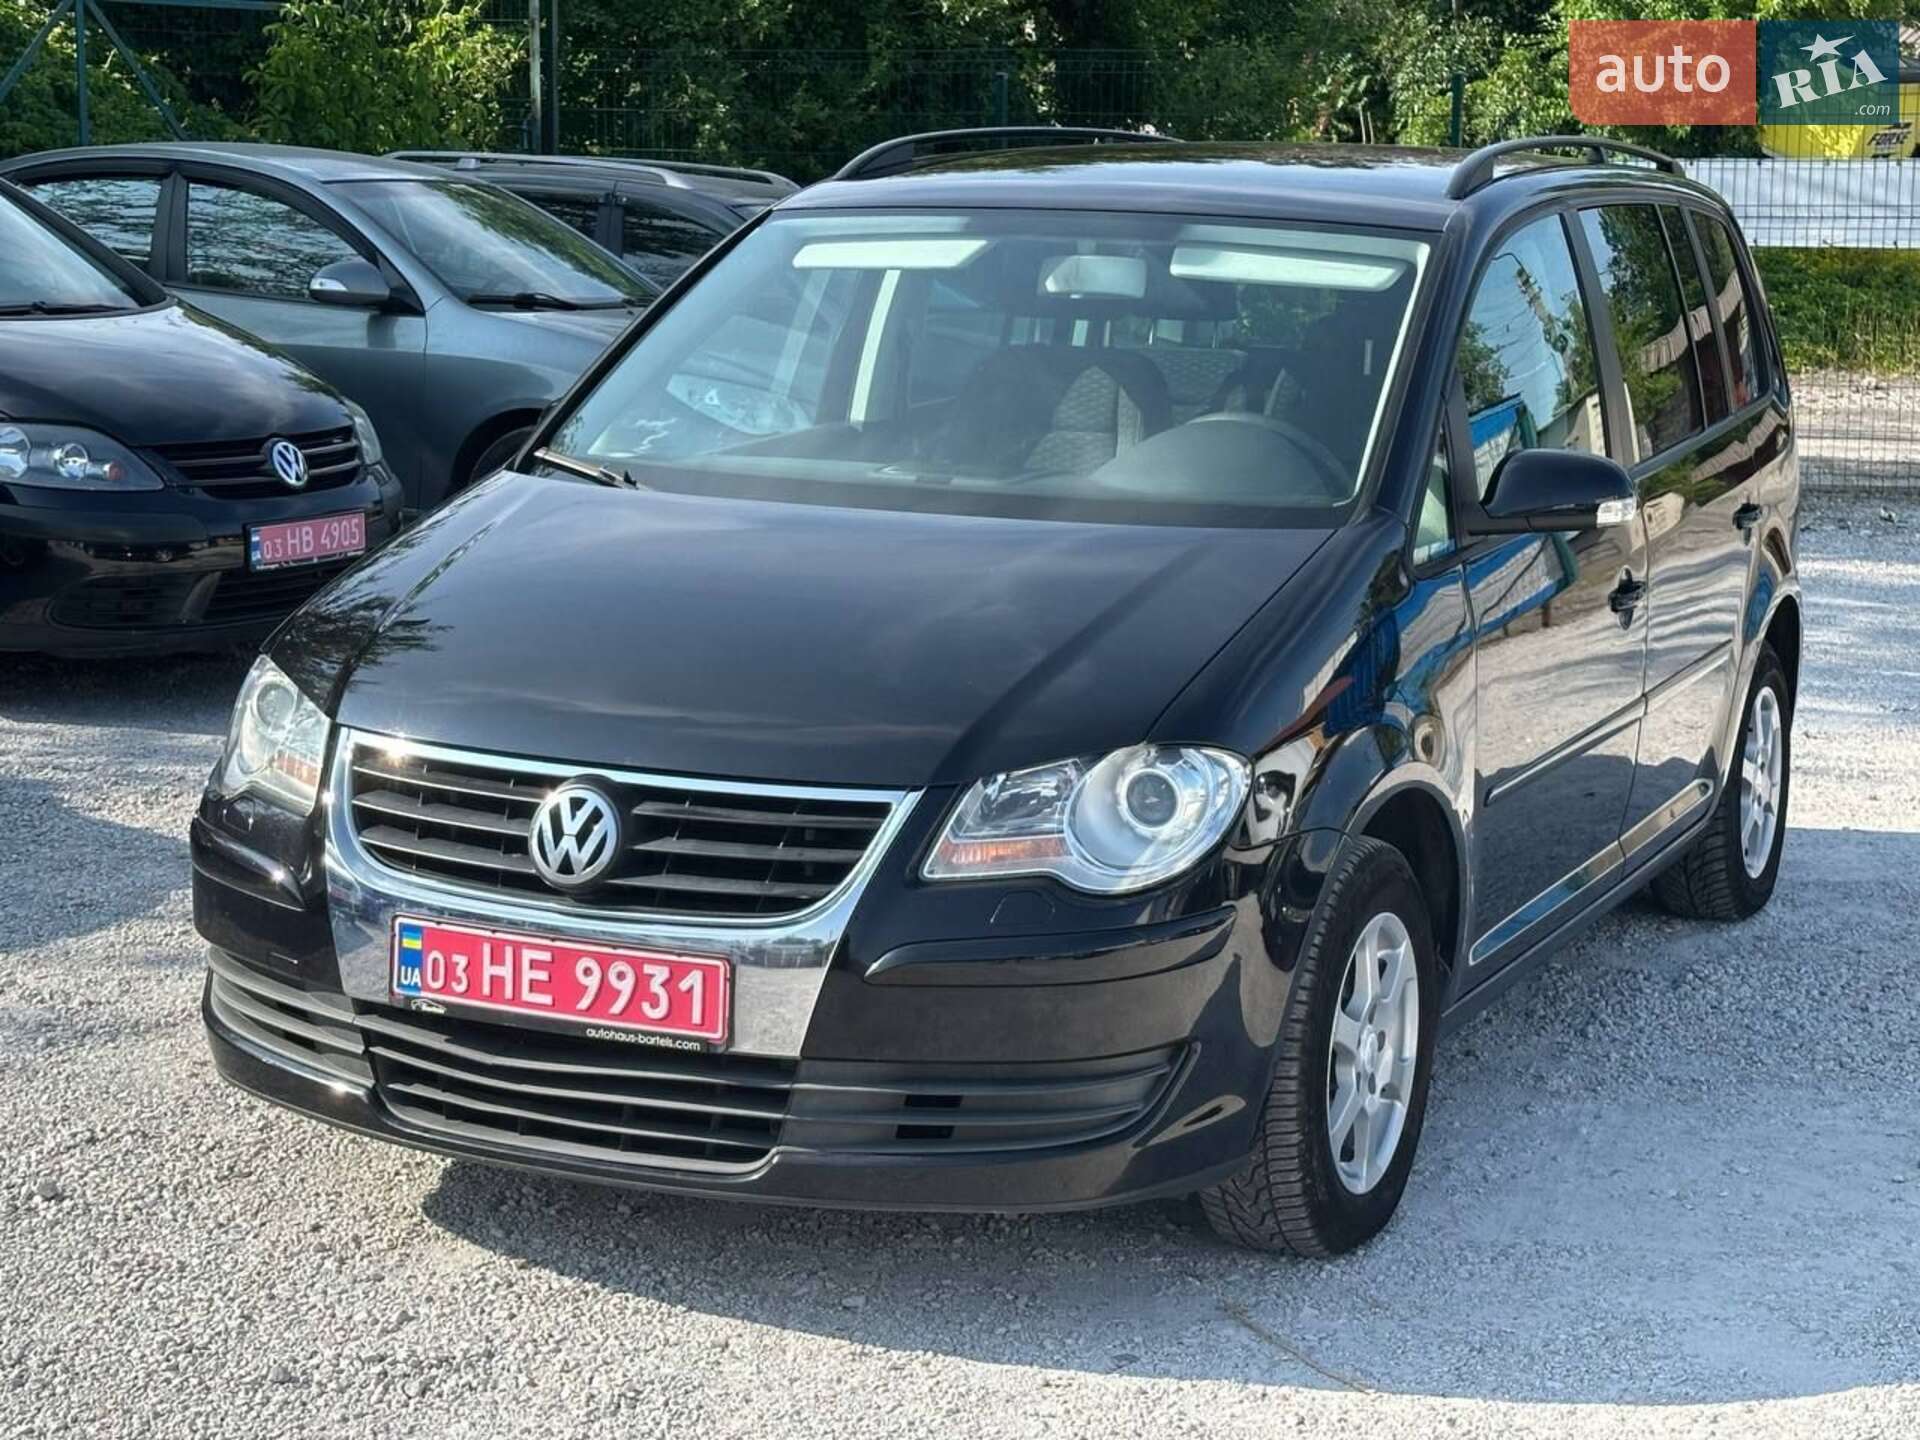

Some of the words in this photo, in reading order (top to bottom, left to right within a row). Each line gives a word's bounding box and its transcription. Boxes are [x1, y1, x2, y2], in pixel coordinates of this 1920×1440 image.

[263, 539, 282, 559] 03
[286, 526, 314, 556] HB
[321, 518, 360, 550] 4905
[530, 784, 619, 887] VW
[401, 966, 421, 987] UA
[426, 950, 468, 994] 03
[482, 943, 554, 1007] HE
[575, 956, 704, 1025] 9931
